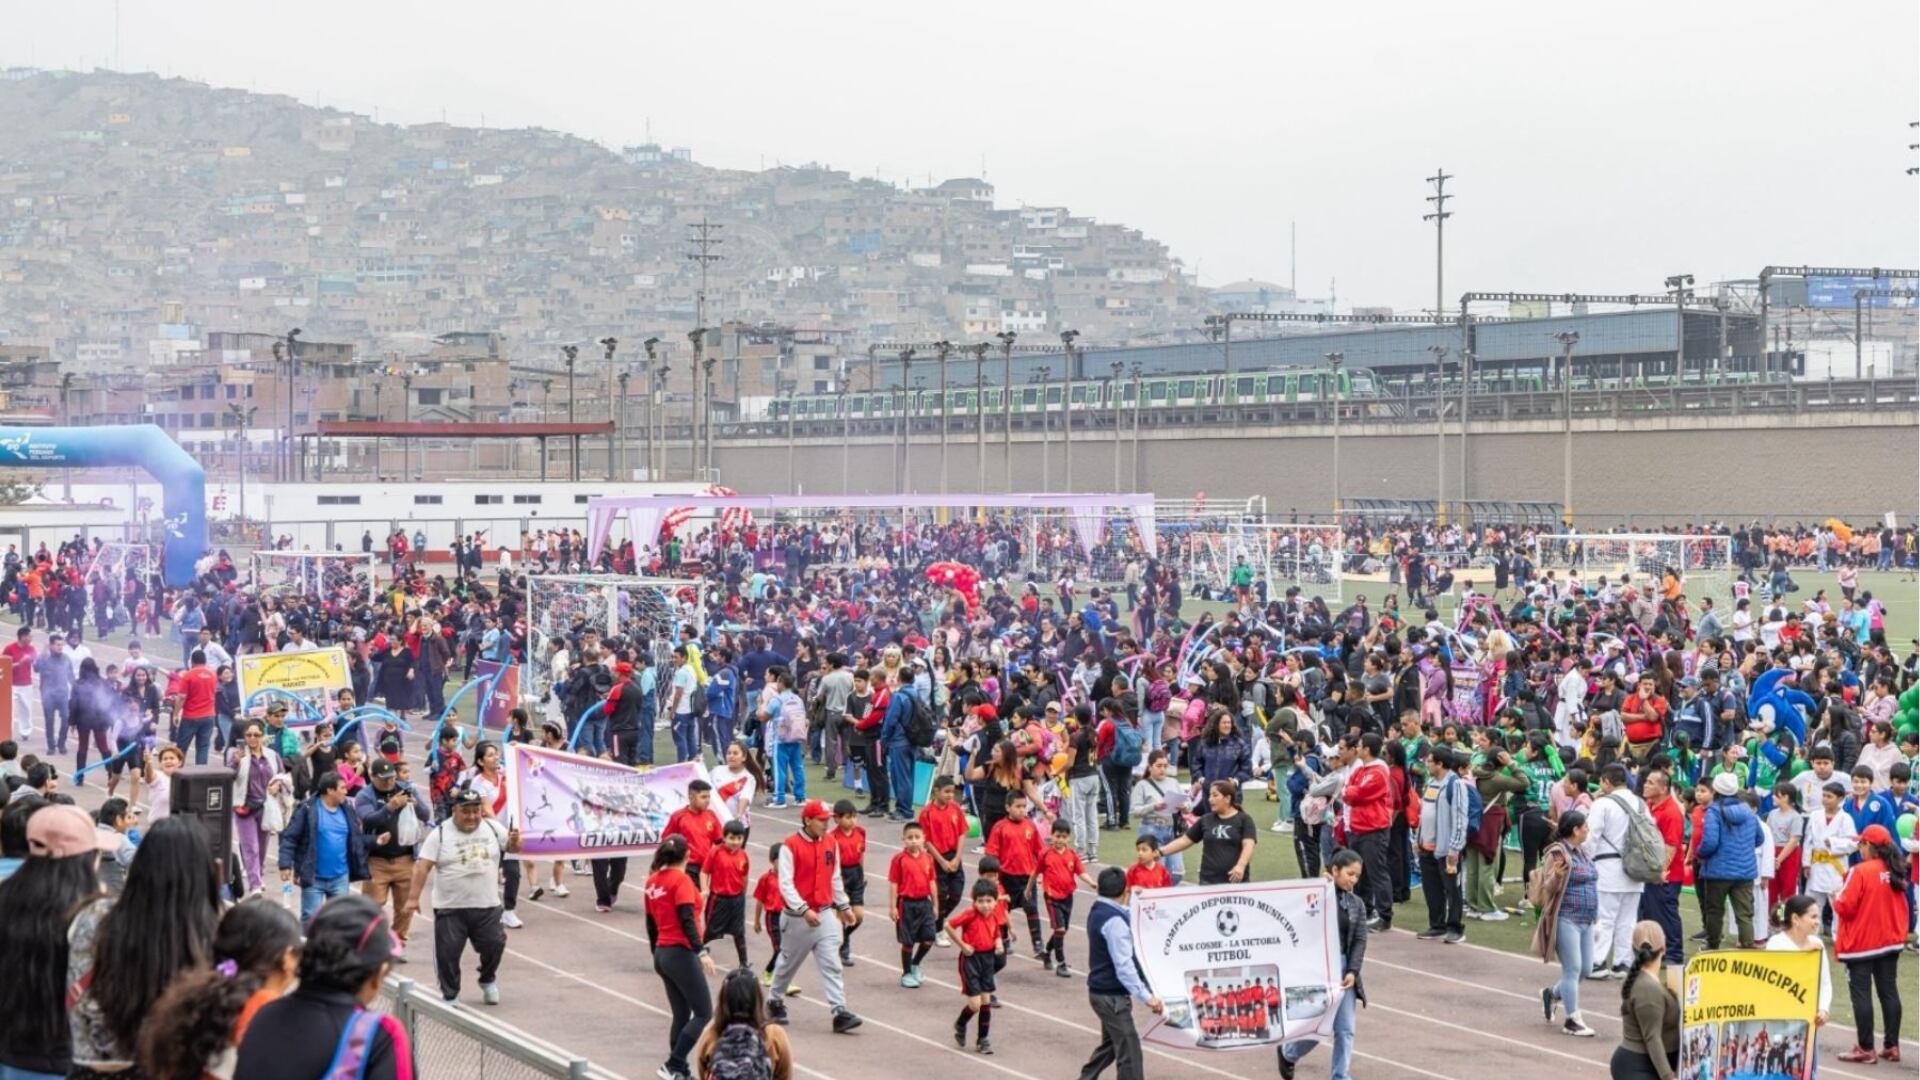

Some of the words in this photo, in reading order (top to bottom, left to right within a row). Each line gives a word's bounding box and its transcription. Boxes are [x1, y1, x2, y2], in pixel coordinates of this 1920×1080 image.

[1163, 904, 1200, 956] COMPLEJO
[1201, 896, 1255, 911] DEPORTIVO
[1257, 901, 1299, 947] MUNICIPAL
[1179, 943, 1194, 951] SAN
[1195, 941, 1223, 950] COSME
[1230, 939, 1239, 947] LA
[1241, 936, 1281, 946] VICTORIA
[1207, 949, 1251, 962] FUTBOL
[1731, 960, 1808, 1004] MUNICIPAL
[1693, 1008, 1704, 1021] LA
[1706, 1004, 1756, 1019] VICTORIA
